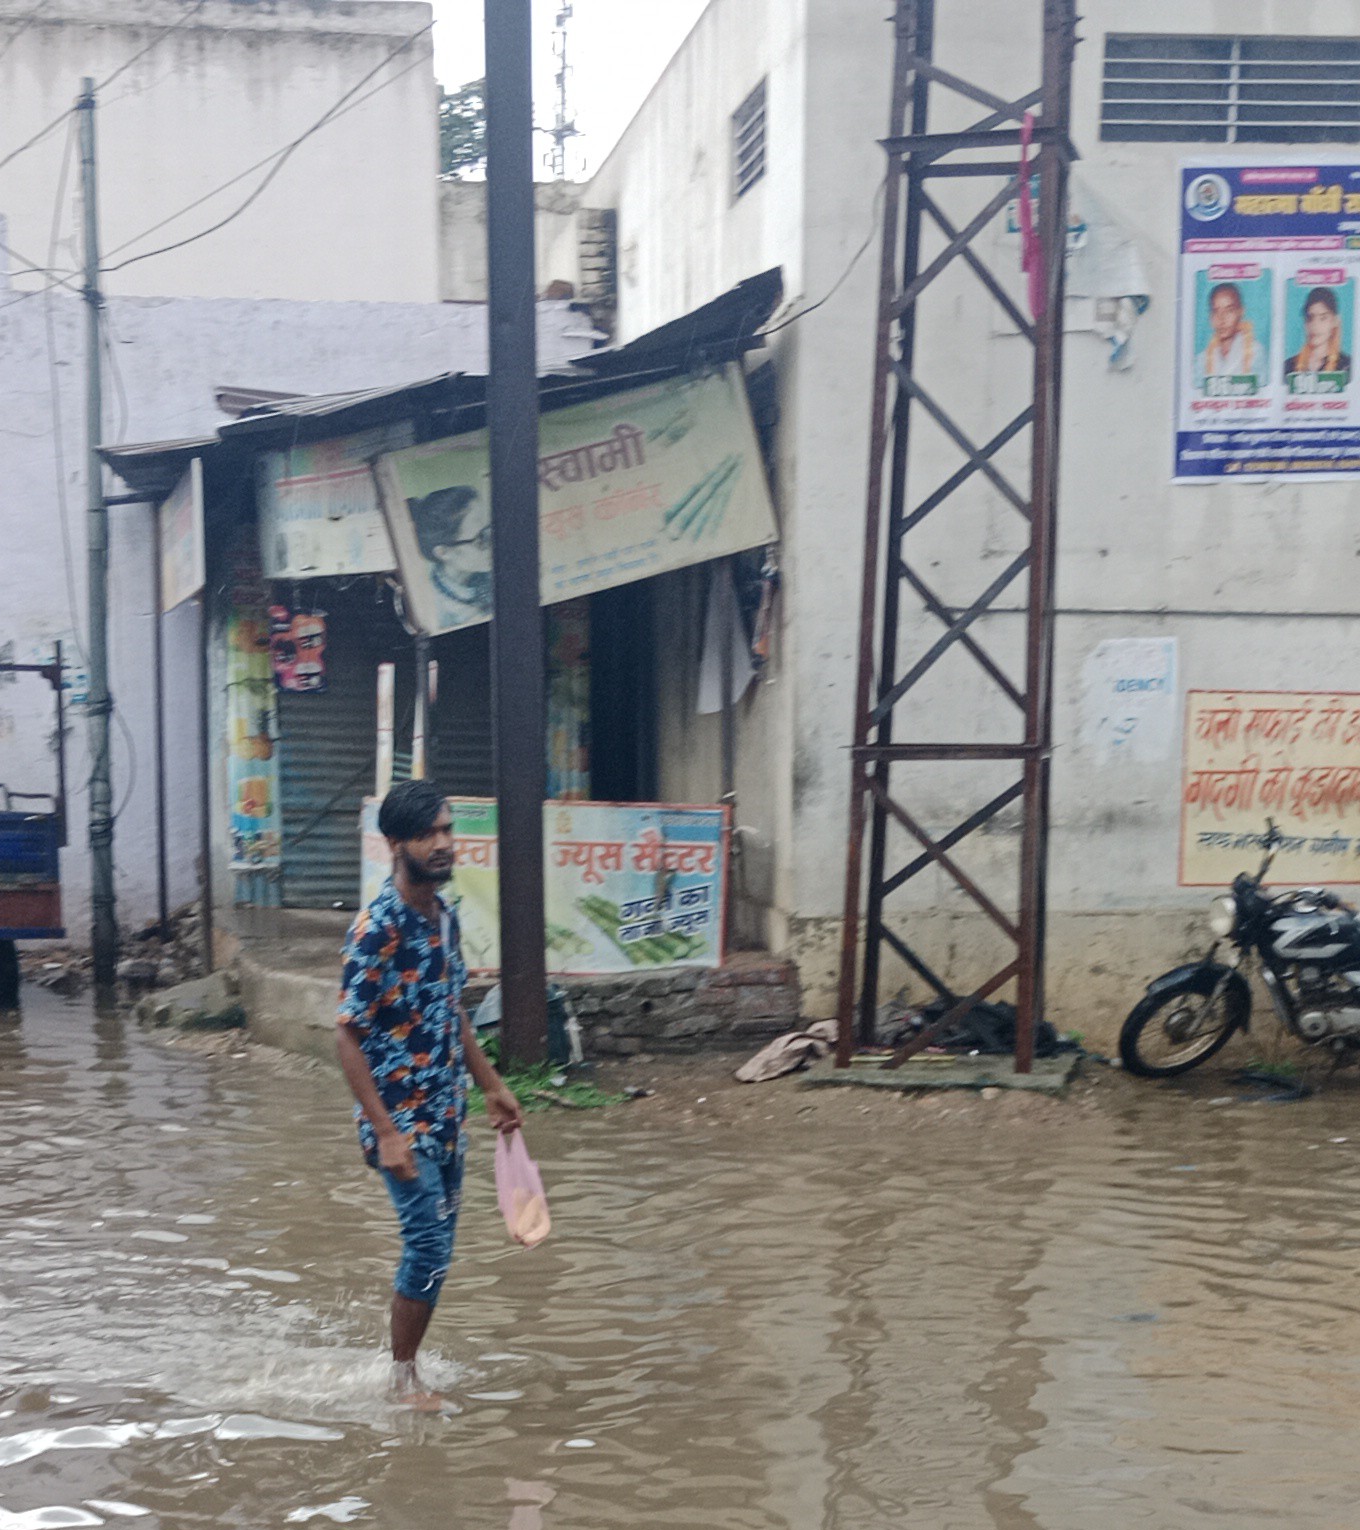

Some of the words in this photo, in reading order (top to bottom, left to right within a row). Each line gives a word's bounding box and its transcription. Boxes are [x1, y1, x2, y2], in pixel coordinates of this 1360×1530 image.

[539, 423, 645, 492] स्वामी
[551, 841, 626, 885] ज्यूस
[677, 883, 712, 908] का
